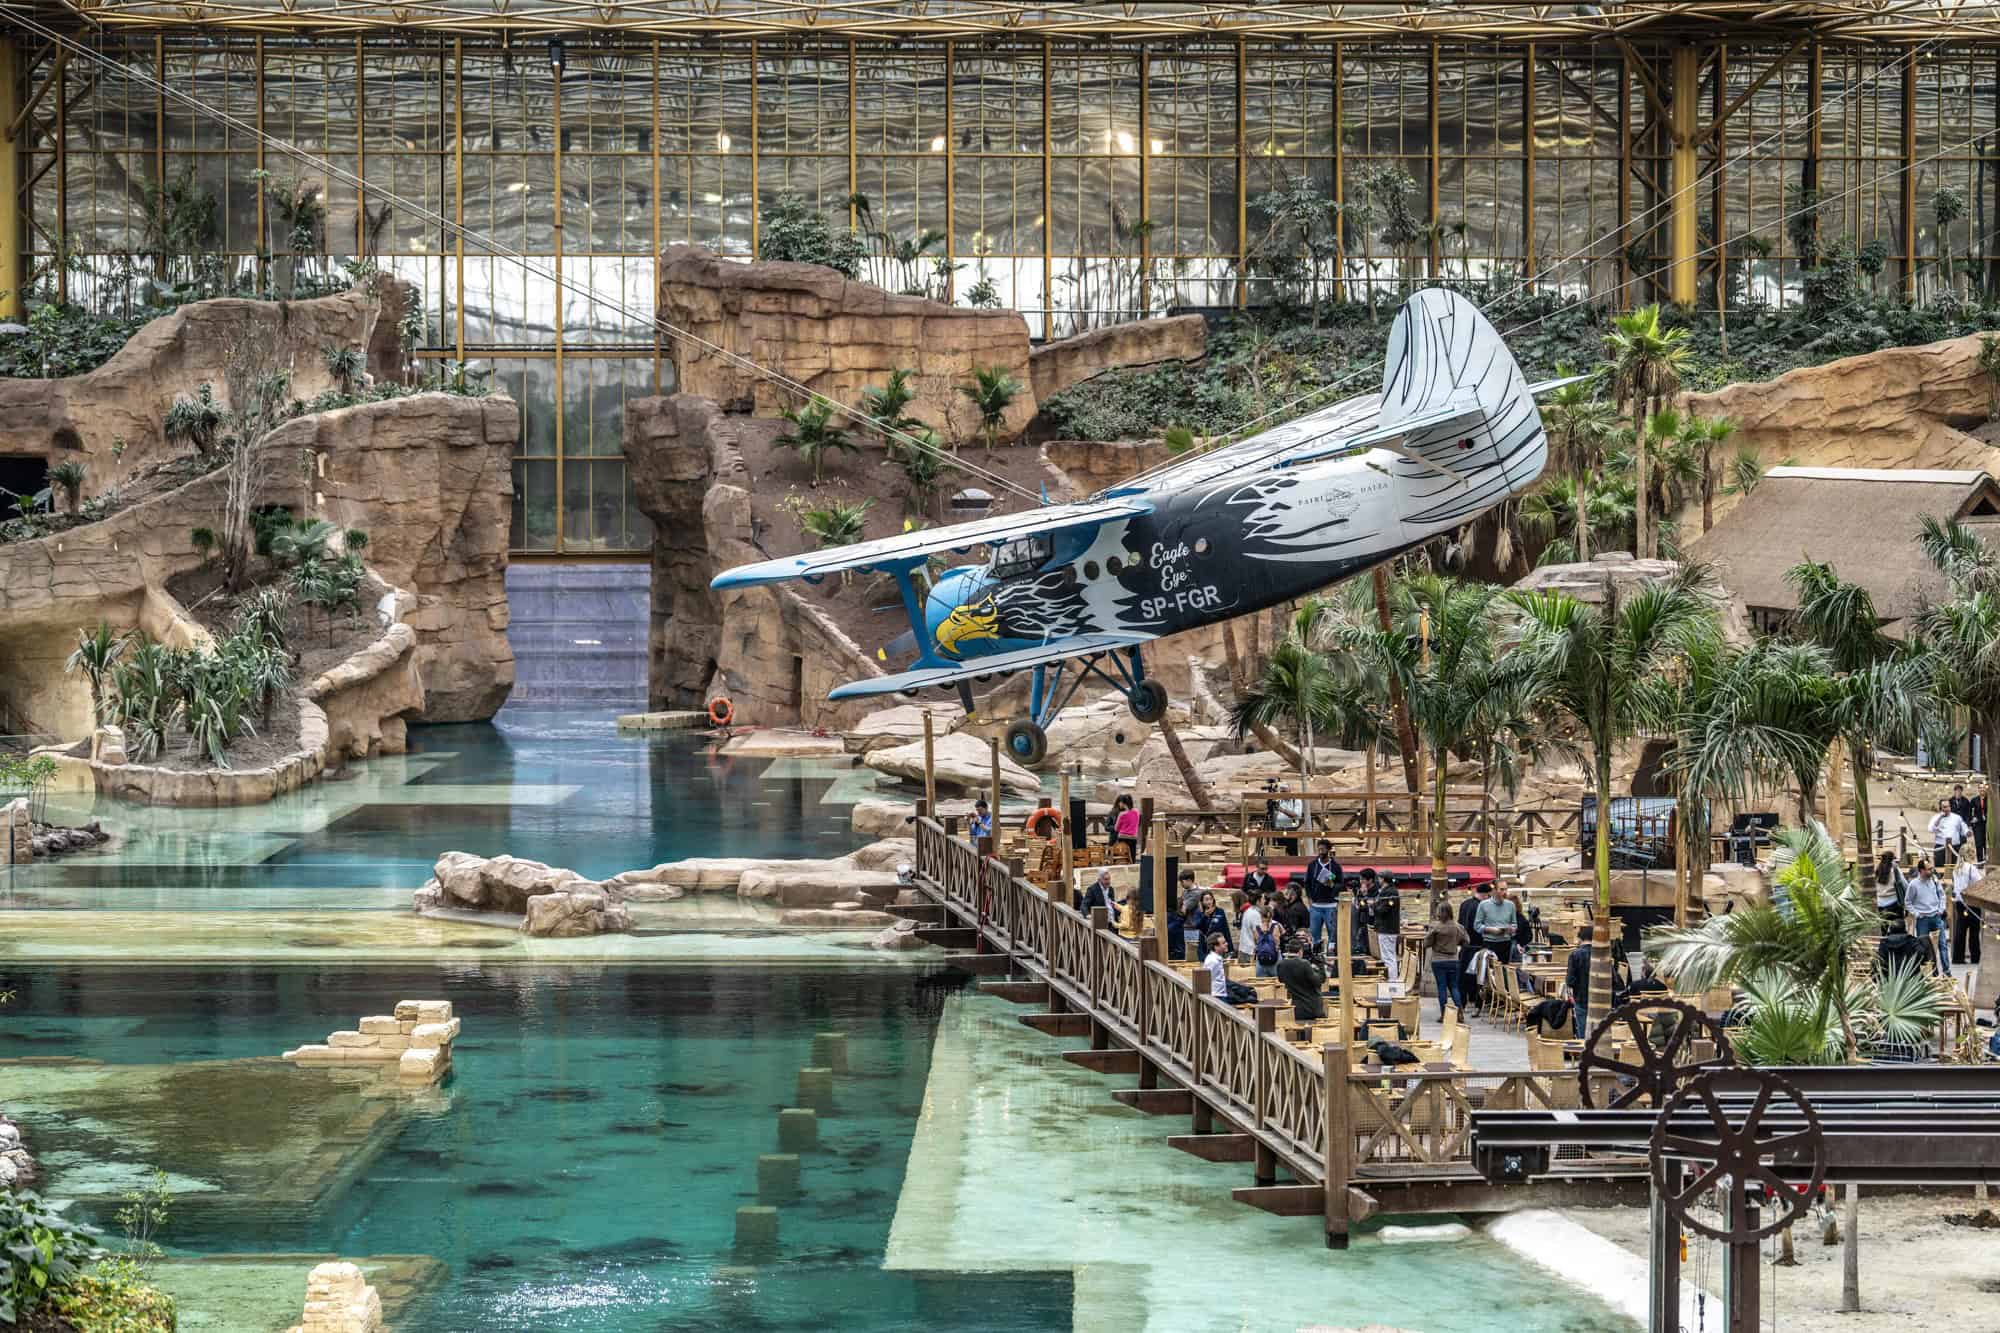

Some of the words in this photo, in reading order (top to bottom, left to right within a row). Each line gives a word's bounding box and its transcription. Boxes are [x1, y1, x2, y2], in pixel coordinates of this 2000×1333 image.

[1150, 542, 1190, 569] Eagle
[1161, 564, 1188, 592] Eye
[1140, 585, 1222, 619] SP-FGR
